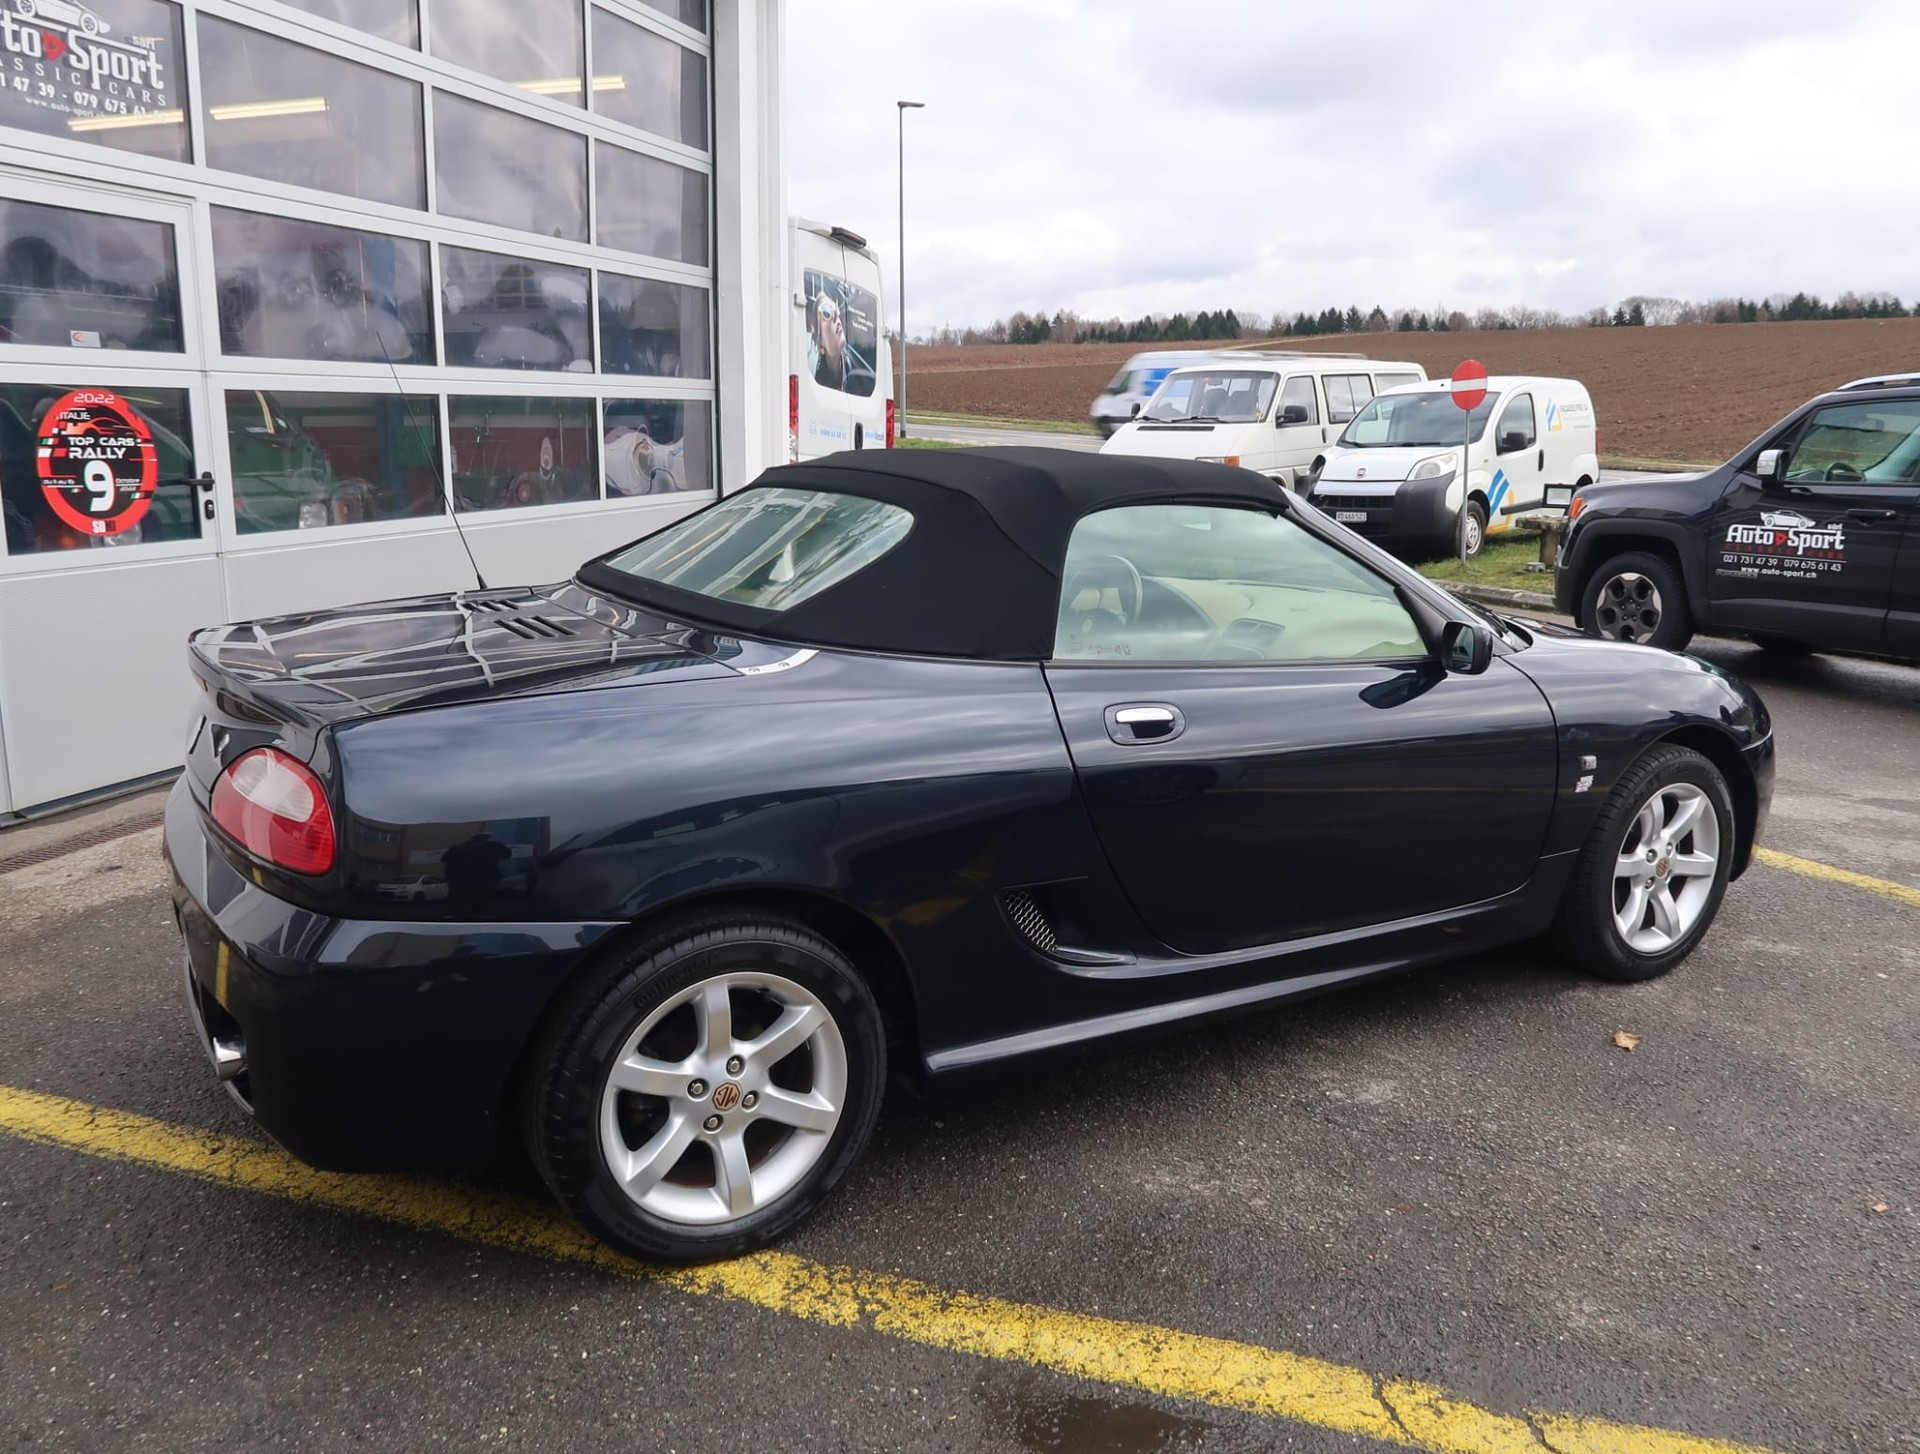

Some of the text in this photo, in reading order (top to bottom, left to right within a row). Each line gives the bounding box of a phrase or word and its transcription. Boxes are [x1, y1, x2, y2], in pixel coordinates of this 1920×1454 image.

[0, 9, 165, 91] to Sport
[13, 76, 30, 92] 47
[38, 82, 55, 98] 39
[73, 90, 98, 108] 079
[104, 98, 127, 115] 675
[108, 81, 166, 106] CARS
[74, 393, 115, 404] 2022
[60, 411, 90, 420] ITALIE
[68, 436, 135, 447] TOP CARS
[69, 447, 127, 459] RALLY
[83, 459, 114, 512] 9
[1725, 524, 1846, 555] Auto Sport
[1723, 554, 1842, 572] 021 731 47 39 079 675 61 43
[1741, 567, 1817, 579] www.auto-sport.ch
